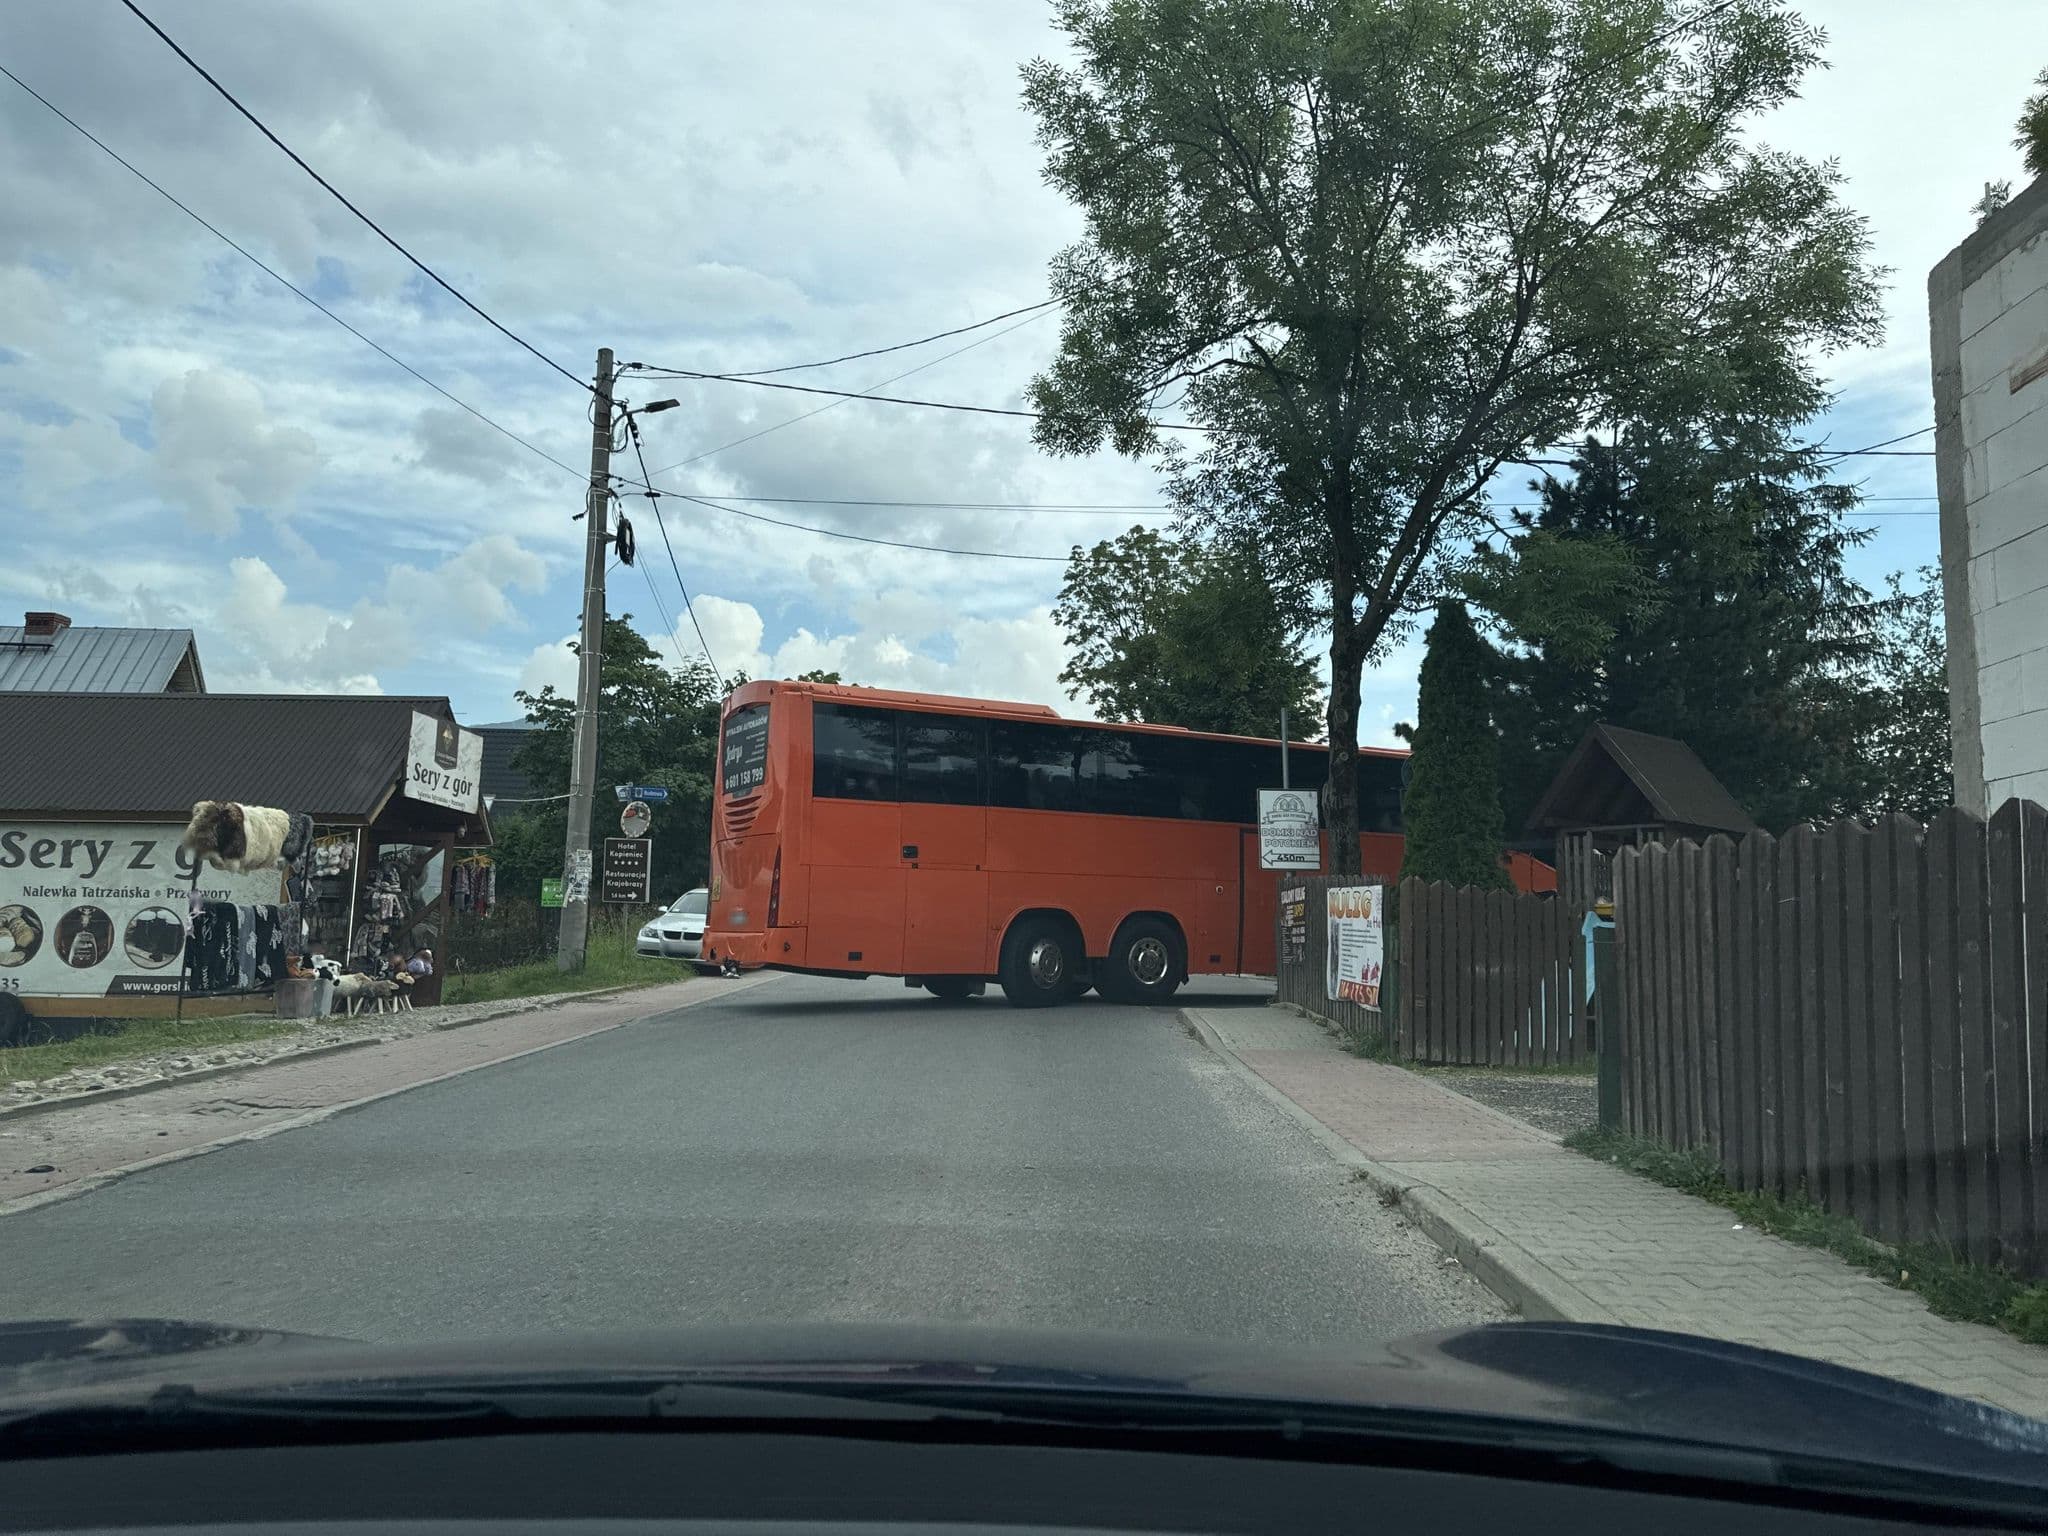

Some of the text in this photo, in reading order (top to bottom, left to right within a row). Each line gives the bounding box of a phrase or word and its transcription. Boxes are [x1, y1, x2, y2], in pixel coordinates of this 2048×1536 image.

[413, 762, 473, 797] Sery z gór
[1262, 827, 1318, 837] DOMKI NAD
[617, 843, 637, 851] Hotel
[0, 831, 114, 879] Sery
[127, 840, 158, 870] z
[609, 850, 644, 859] Kopieniec
[605, 870, 646, 880] Restauracja
[23, 886, 232, 902] Nalewka Tatrzańska Przwory
